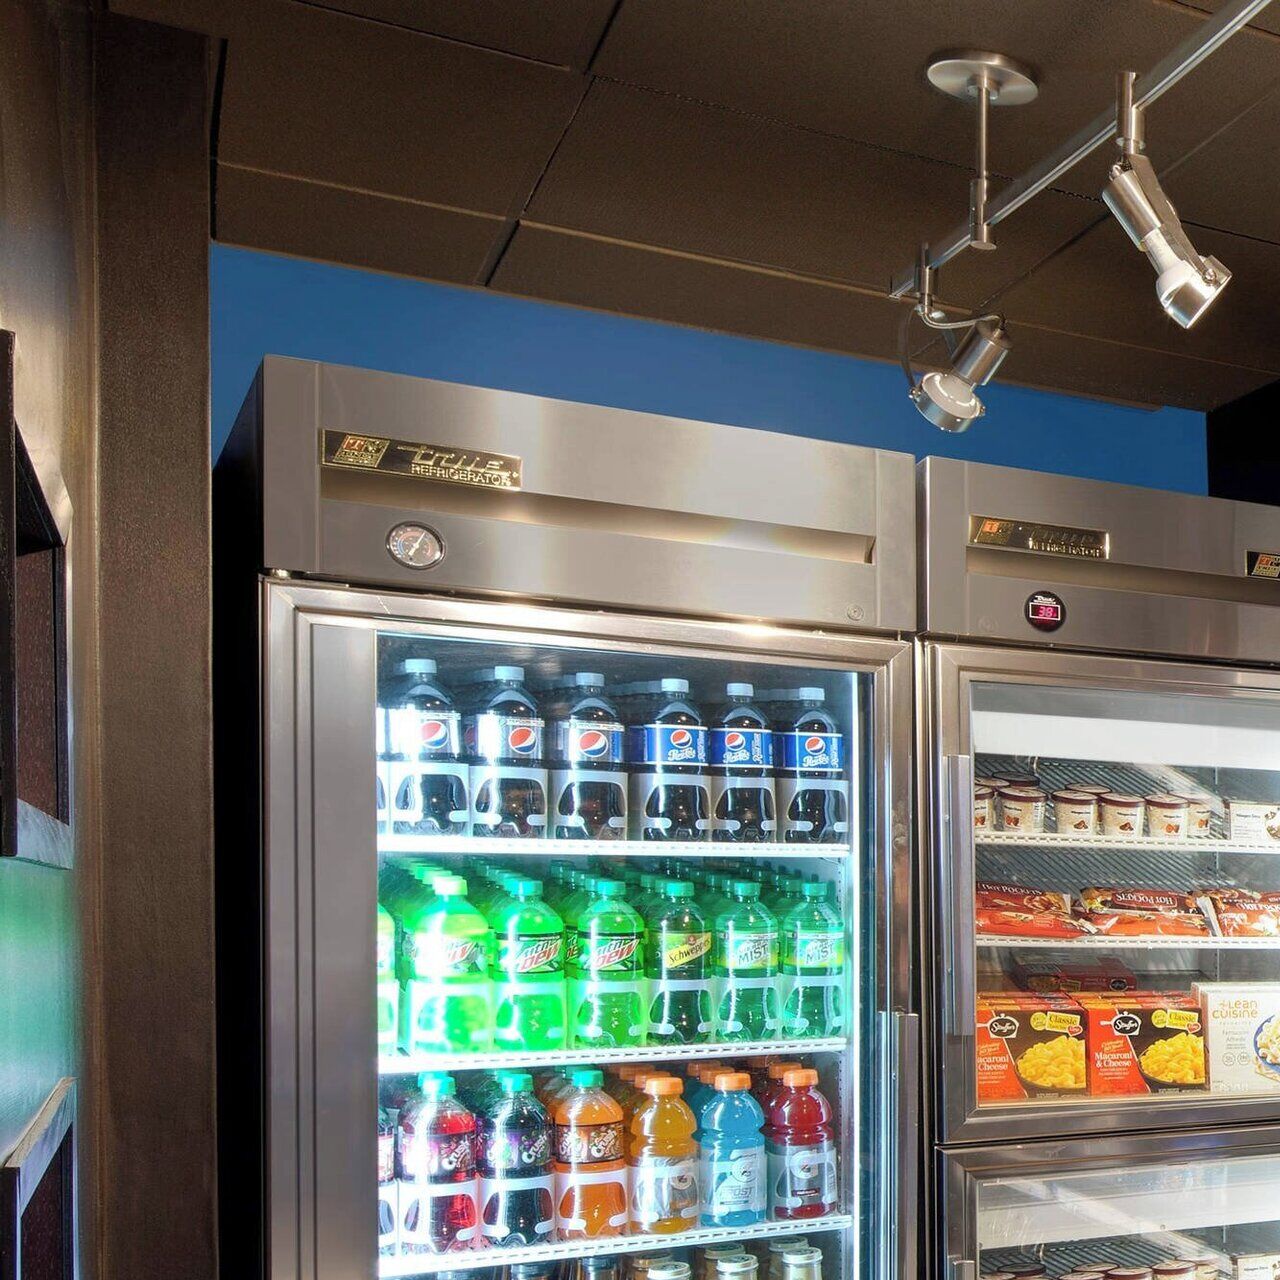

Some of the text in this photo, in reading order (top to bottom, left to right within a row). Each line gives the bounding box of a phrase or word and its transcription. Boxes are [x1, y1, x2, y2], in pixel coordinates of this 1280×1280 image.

[411, 463, 511, 486] REFRIGERATOR
[668, 938, 711, 964] Schweppes
[1094, 1052, 1133, 1061] Macaroni
[1103, 1059, 1132, 1068] Cheese
